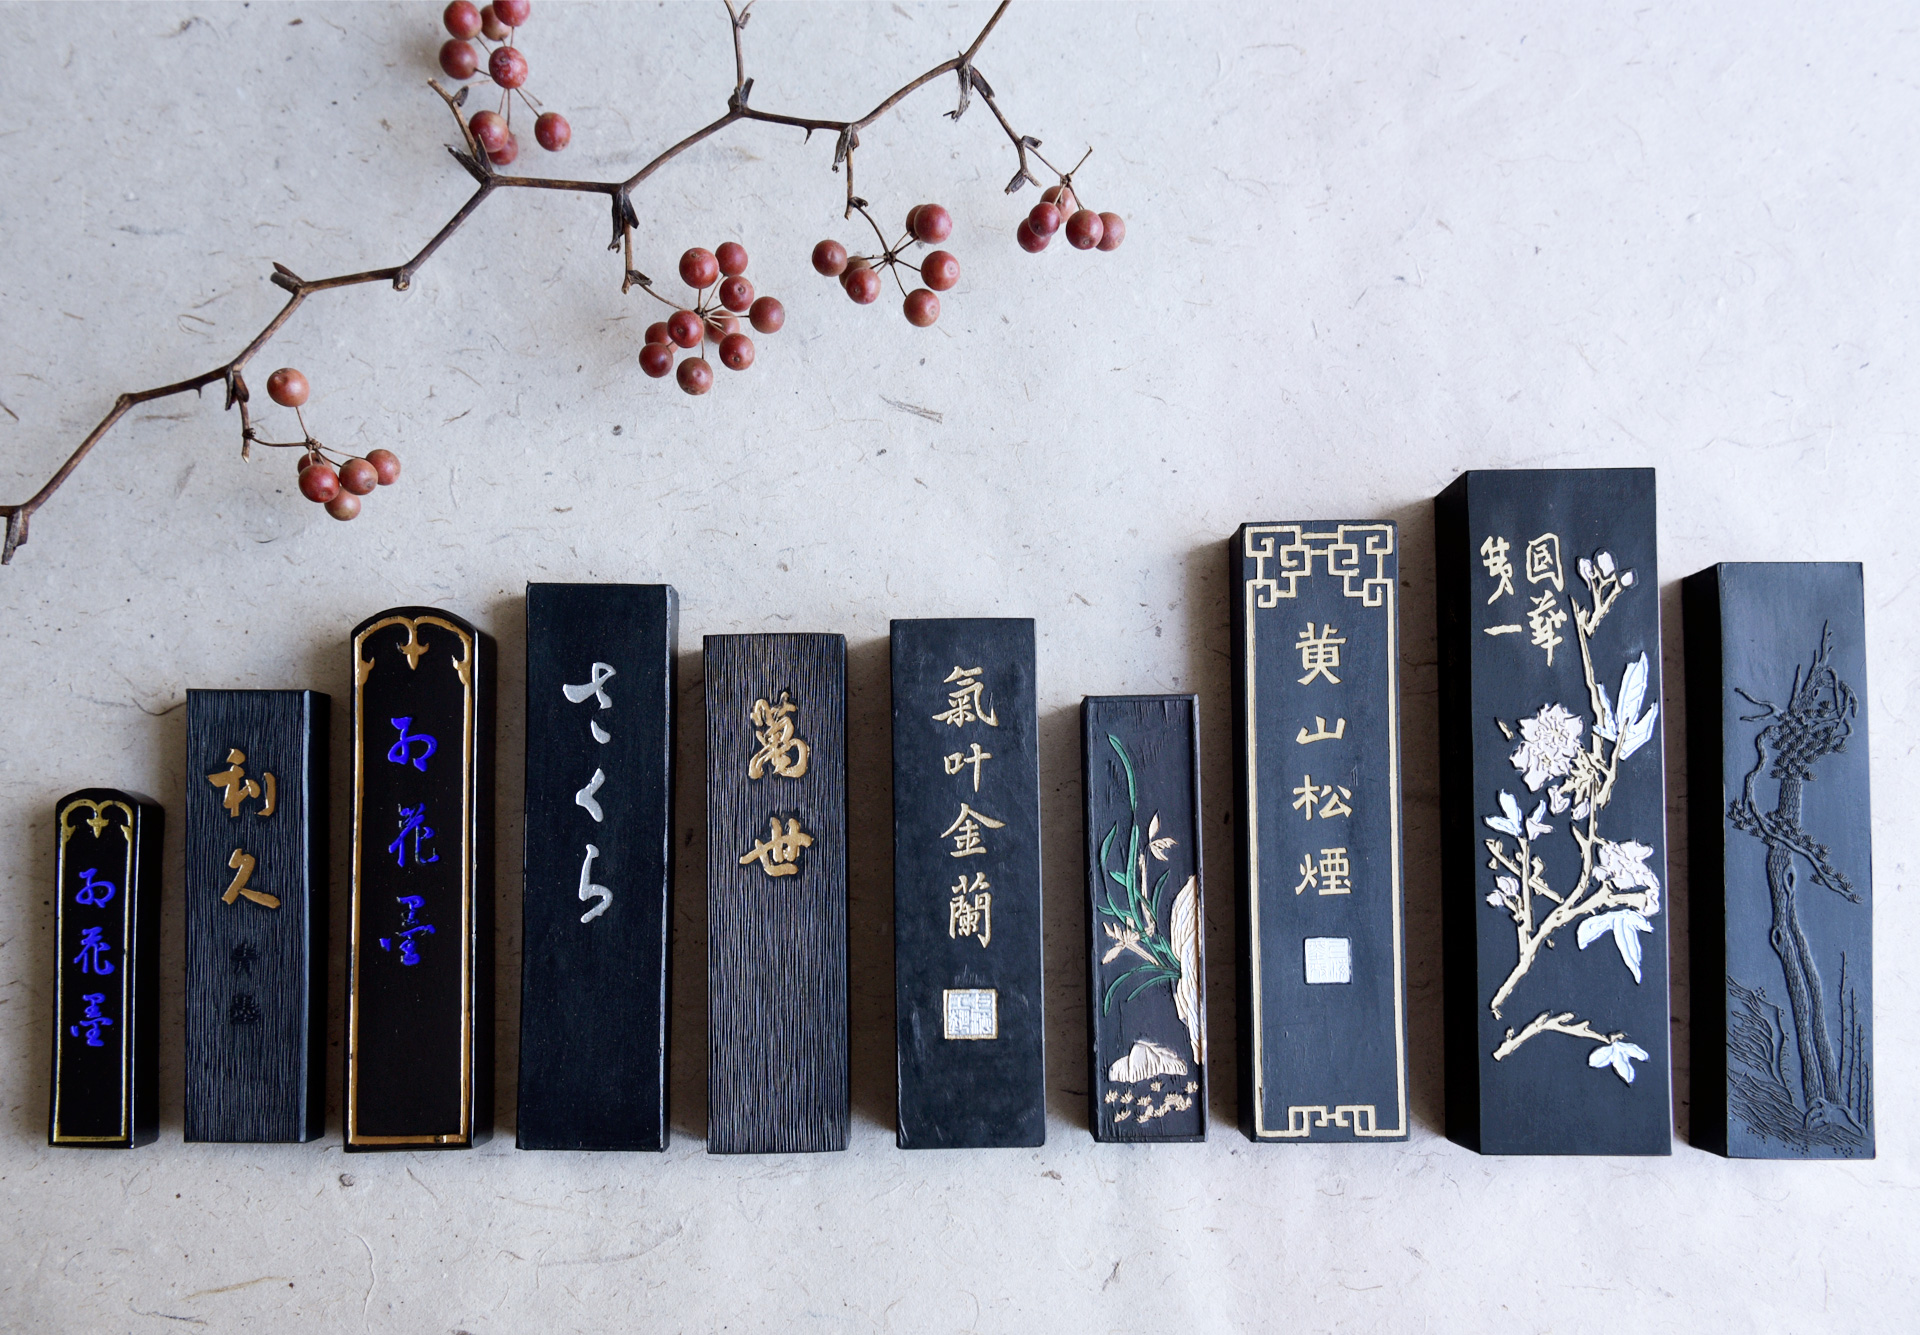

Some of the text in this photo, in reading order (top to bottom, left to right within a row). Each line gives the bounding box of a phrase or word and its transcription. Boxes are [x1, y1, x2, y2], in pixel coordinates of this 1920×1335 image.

[207, 748, 281, 909] 利久
[562, 661, 616, 924] さくら
